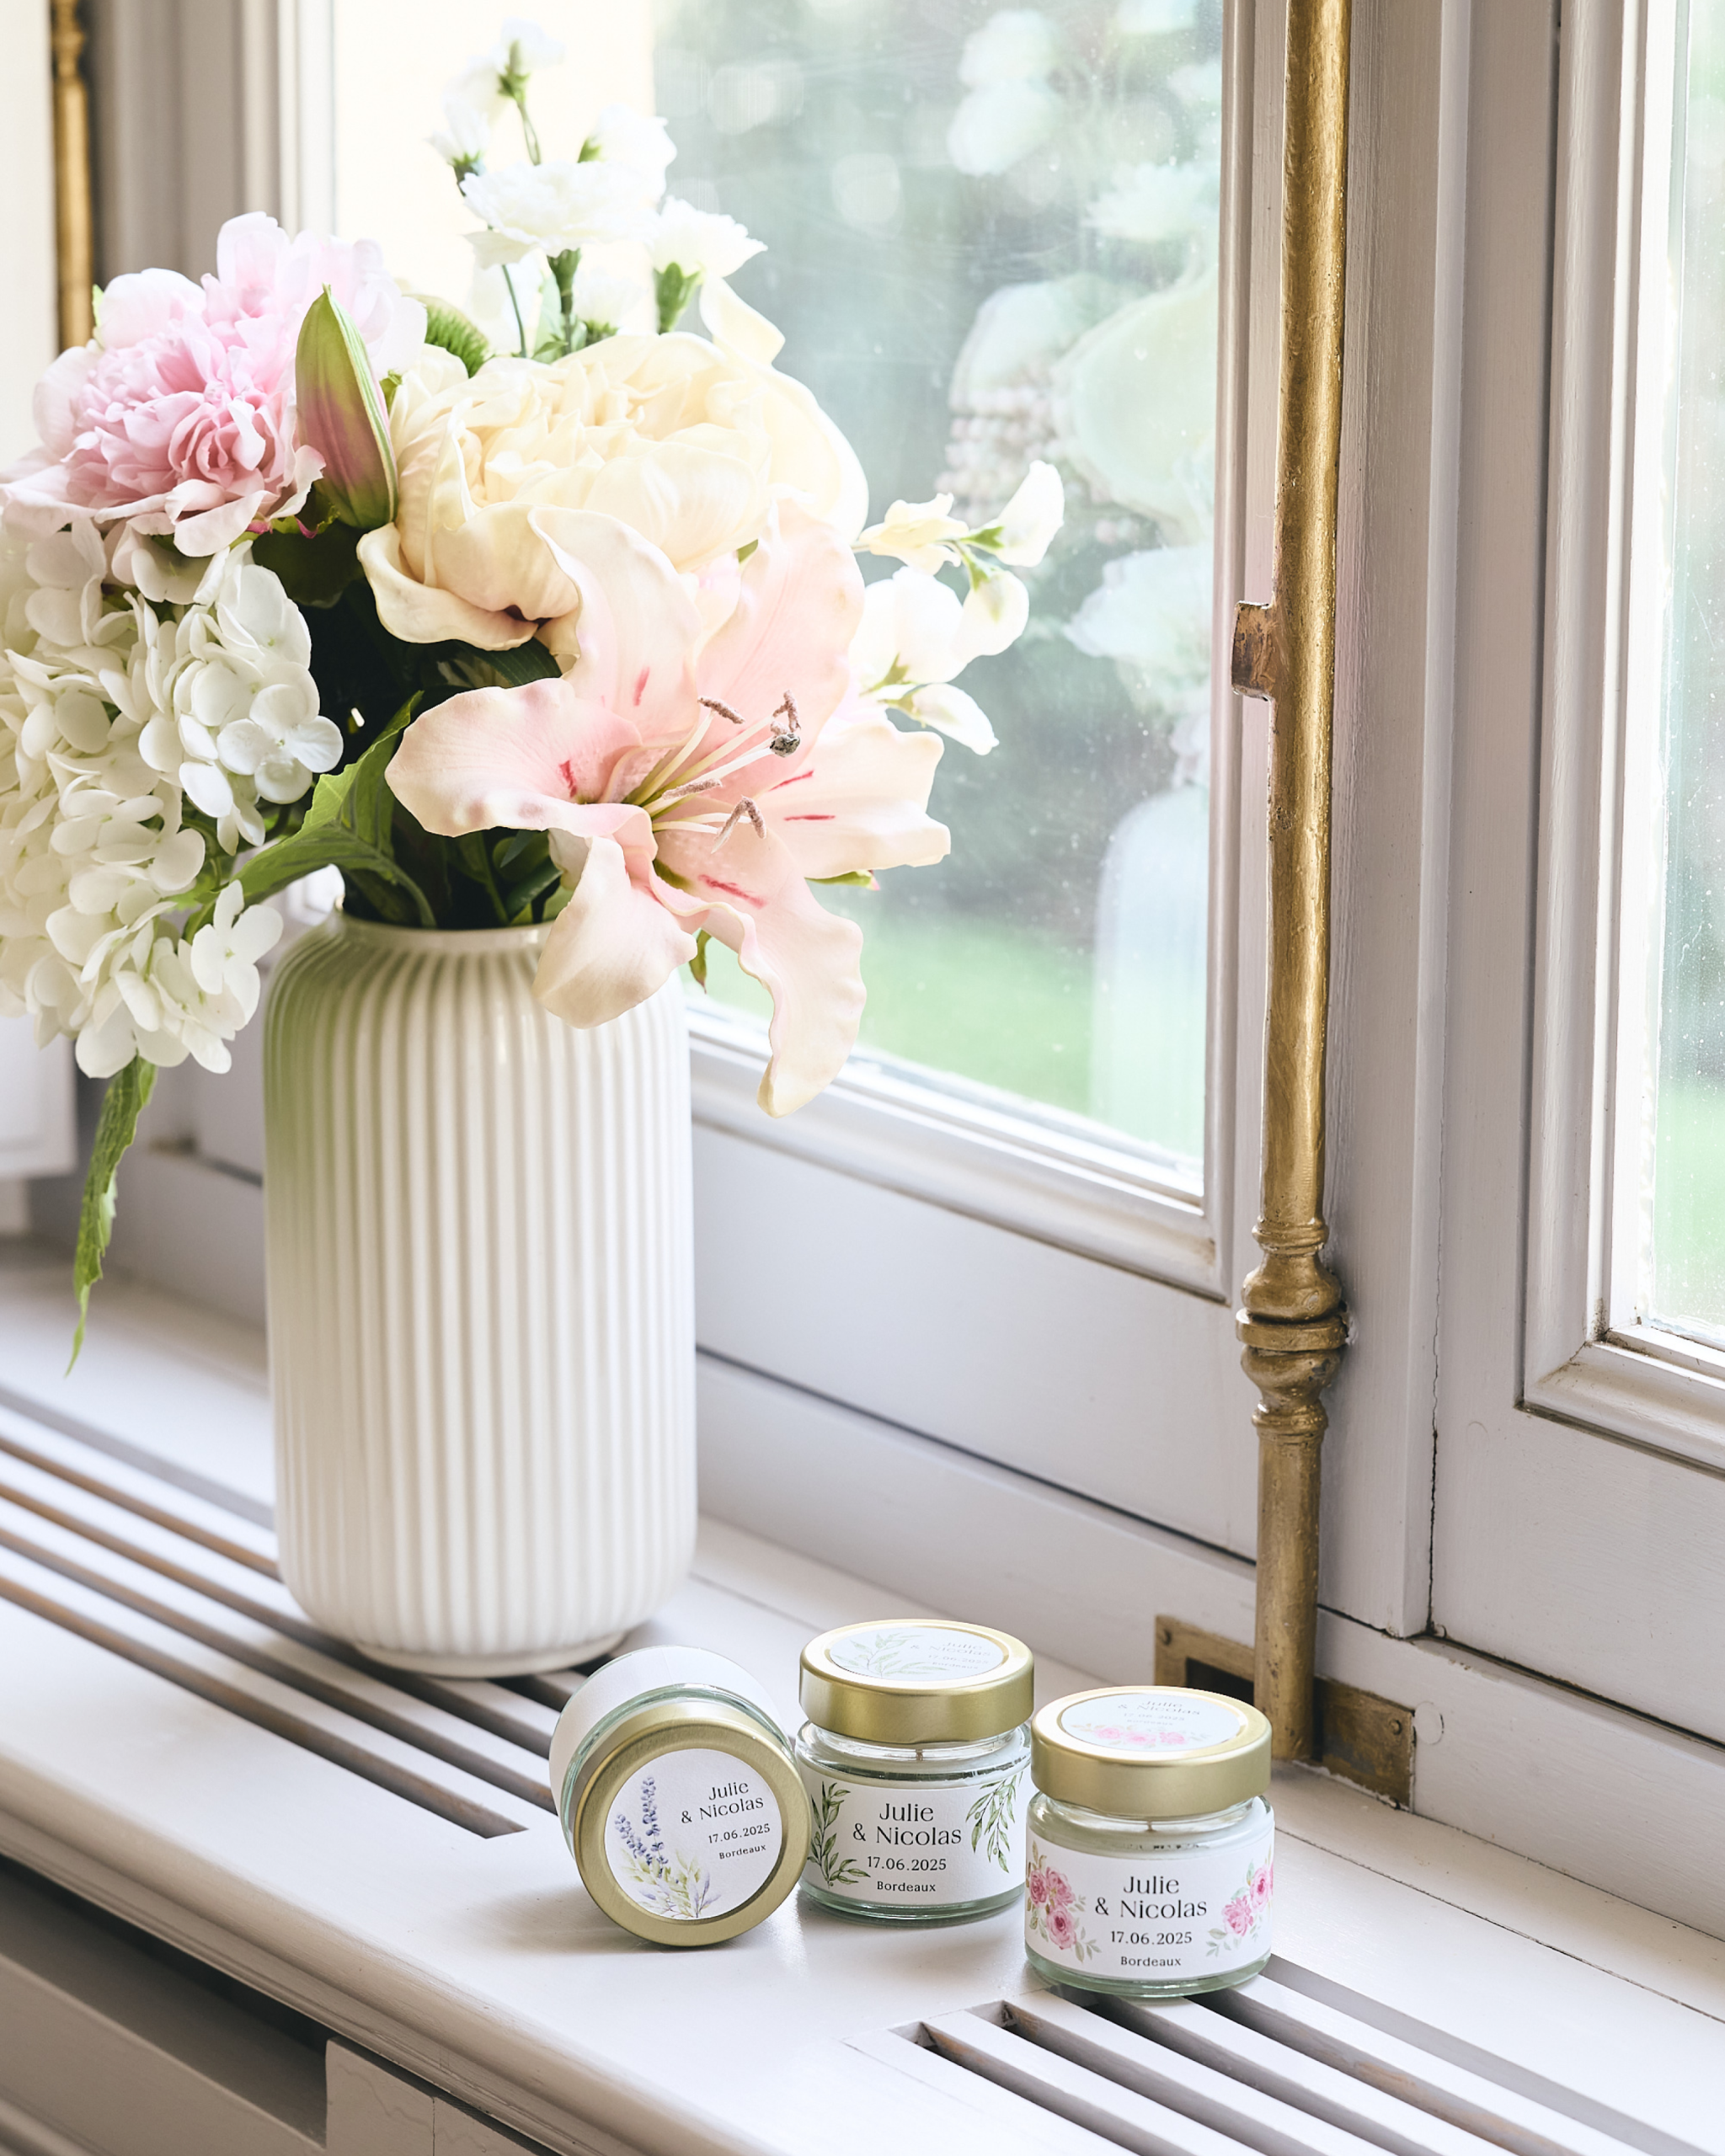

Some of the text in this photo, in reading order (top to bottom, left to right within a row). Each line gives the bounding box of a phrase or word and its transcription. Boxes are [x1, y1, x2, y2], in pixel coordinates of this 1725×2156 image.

[708, 1781, 750, 1801] Julie
[681, 1796, 764, 1824] & Nicolas
[879, 1802, 934, 1822] Julie
[708, 1822, 771, 1844] 17.06.2025
[852, 1822, 962, 1845] & Nicolas
[718, 1844, 766, 1860] Bordeaux
[867, 1855, 947, 1870] 17.06.2025
[877, 1881, 937, 1892] Bordeaux
[1123, 1875, 1180, 1894] Julie
[1095, 1897, 1207, 1919] & Nicolas
[1110, 1930, 1193, 1945] 17.06.2025
[1120, 1956, 1182, 1967] Bordeaux
